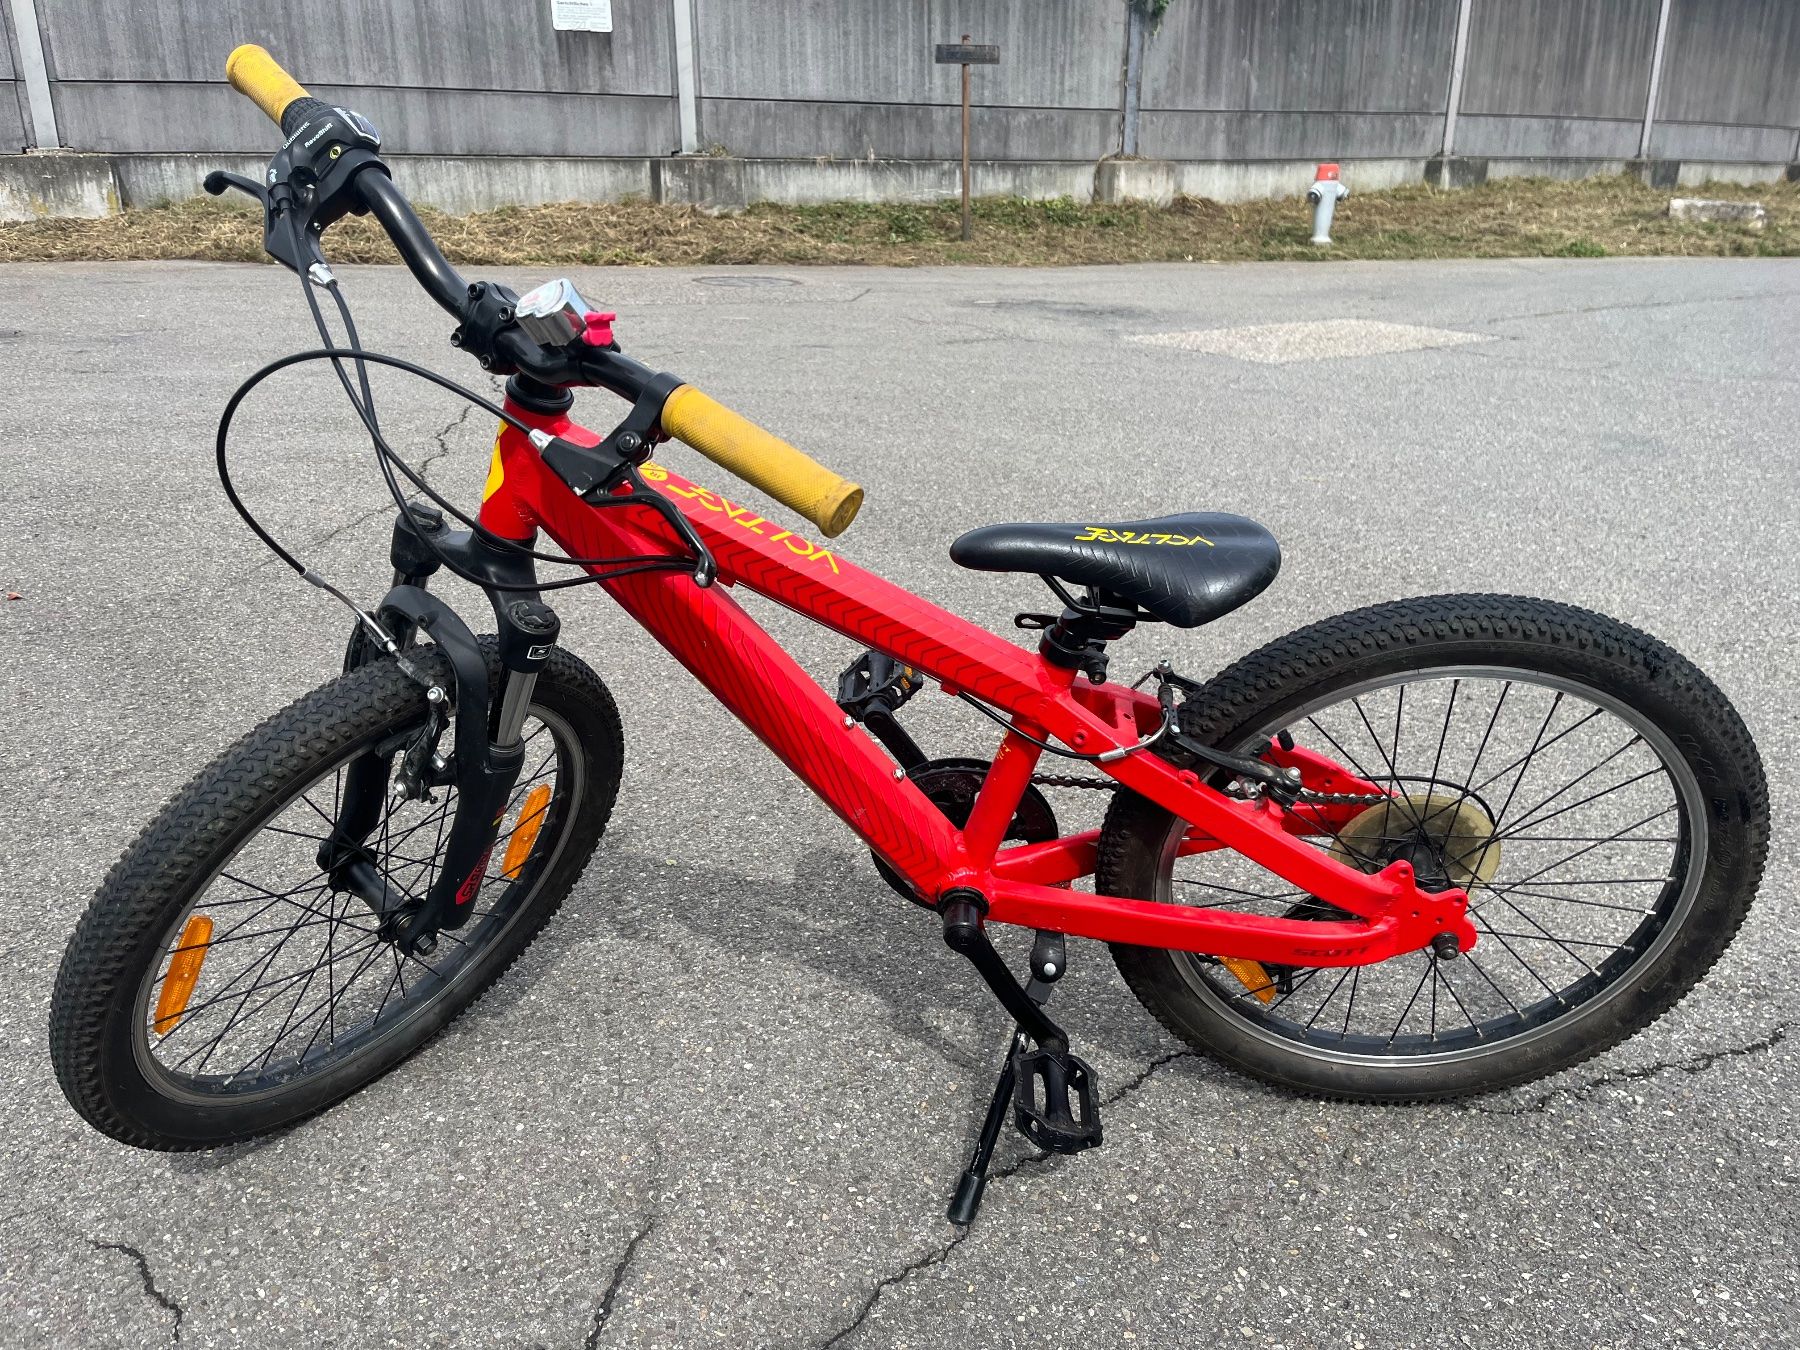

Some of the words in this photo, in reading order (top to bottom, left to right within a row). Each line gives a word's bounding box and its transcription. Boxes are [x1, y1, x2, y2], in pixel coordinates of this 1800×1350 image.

[666, 484, 839, 574] VOLTAGE
[1074, 526, 1215, 547] VOLTAGE
[1293, 945, 1369, 957] SCOTT
